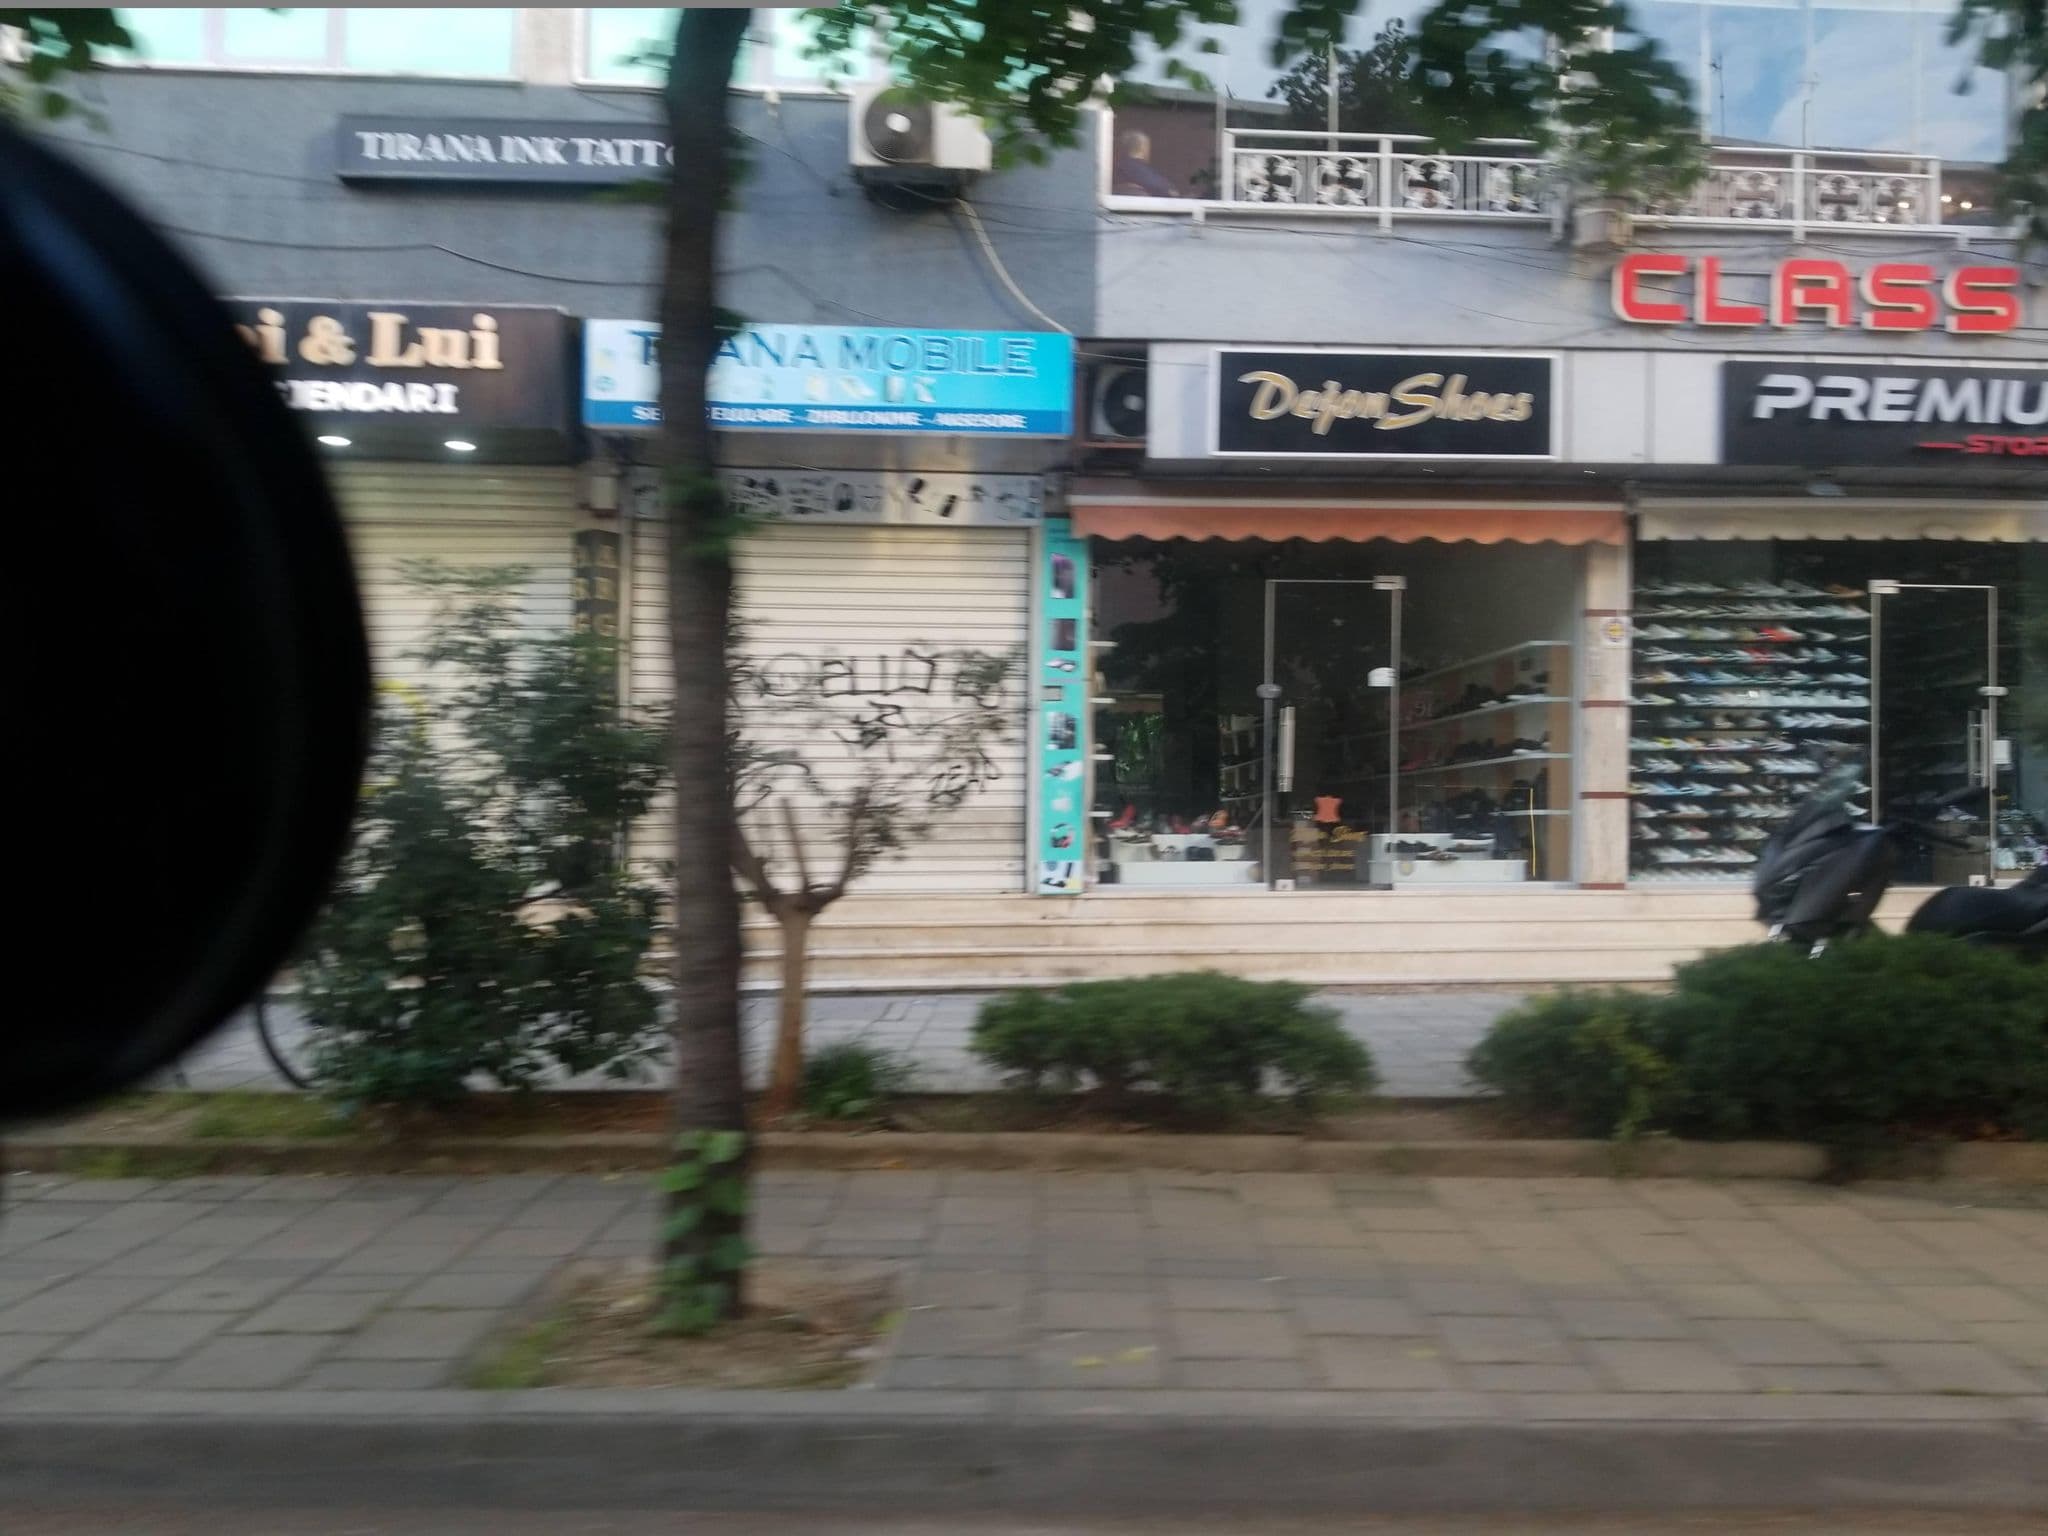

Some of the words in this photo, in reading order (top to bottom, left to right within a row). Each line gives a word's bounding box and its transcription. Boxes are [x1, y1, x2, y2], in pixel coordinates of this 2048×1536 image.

[355, 131, 498, 163] TIRANA
[499, 135, 569, 165] INK
[1612, 253, 2021, 334] CLASS
[298, 315, 356, 366] &
[364, 312, 504, 370] Lui
[836, 333, 1037, 377] MOBILE
